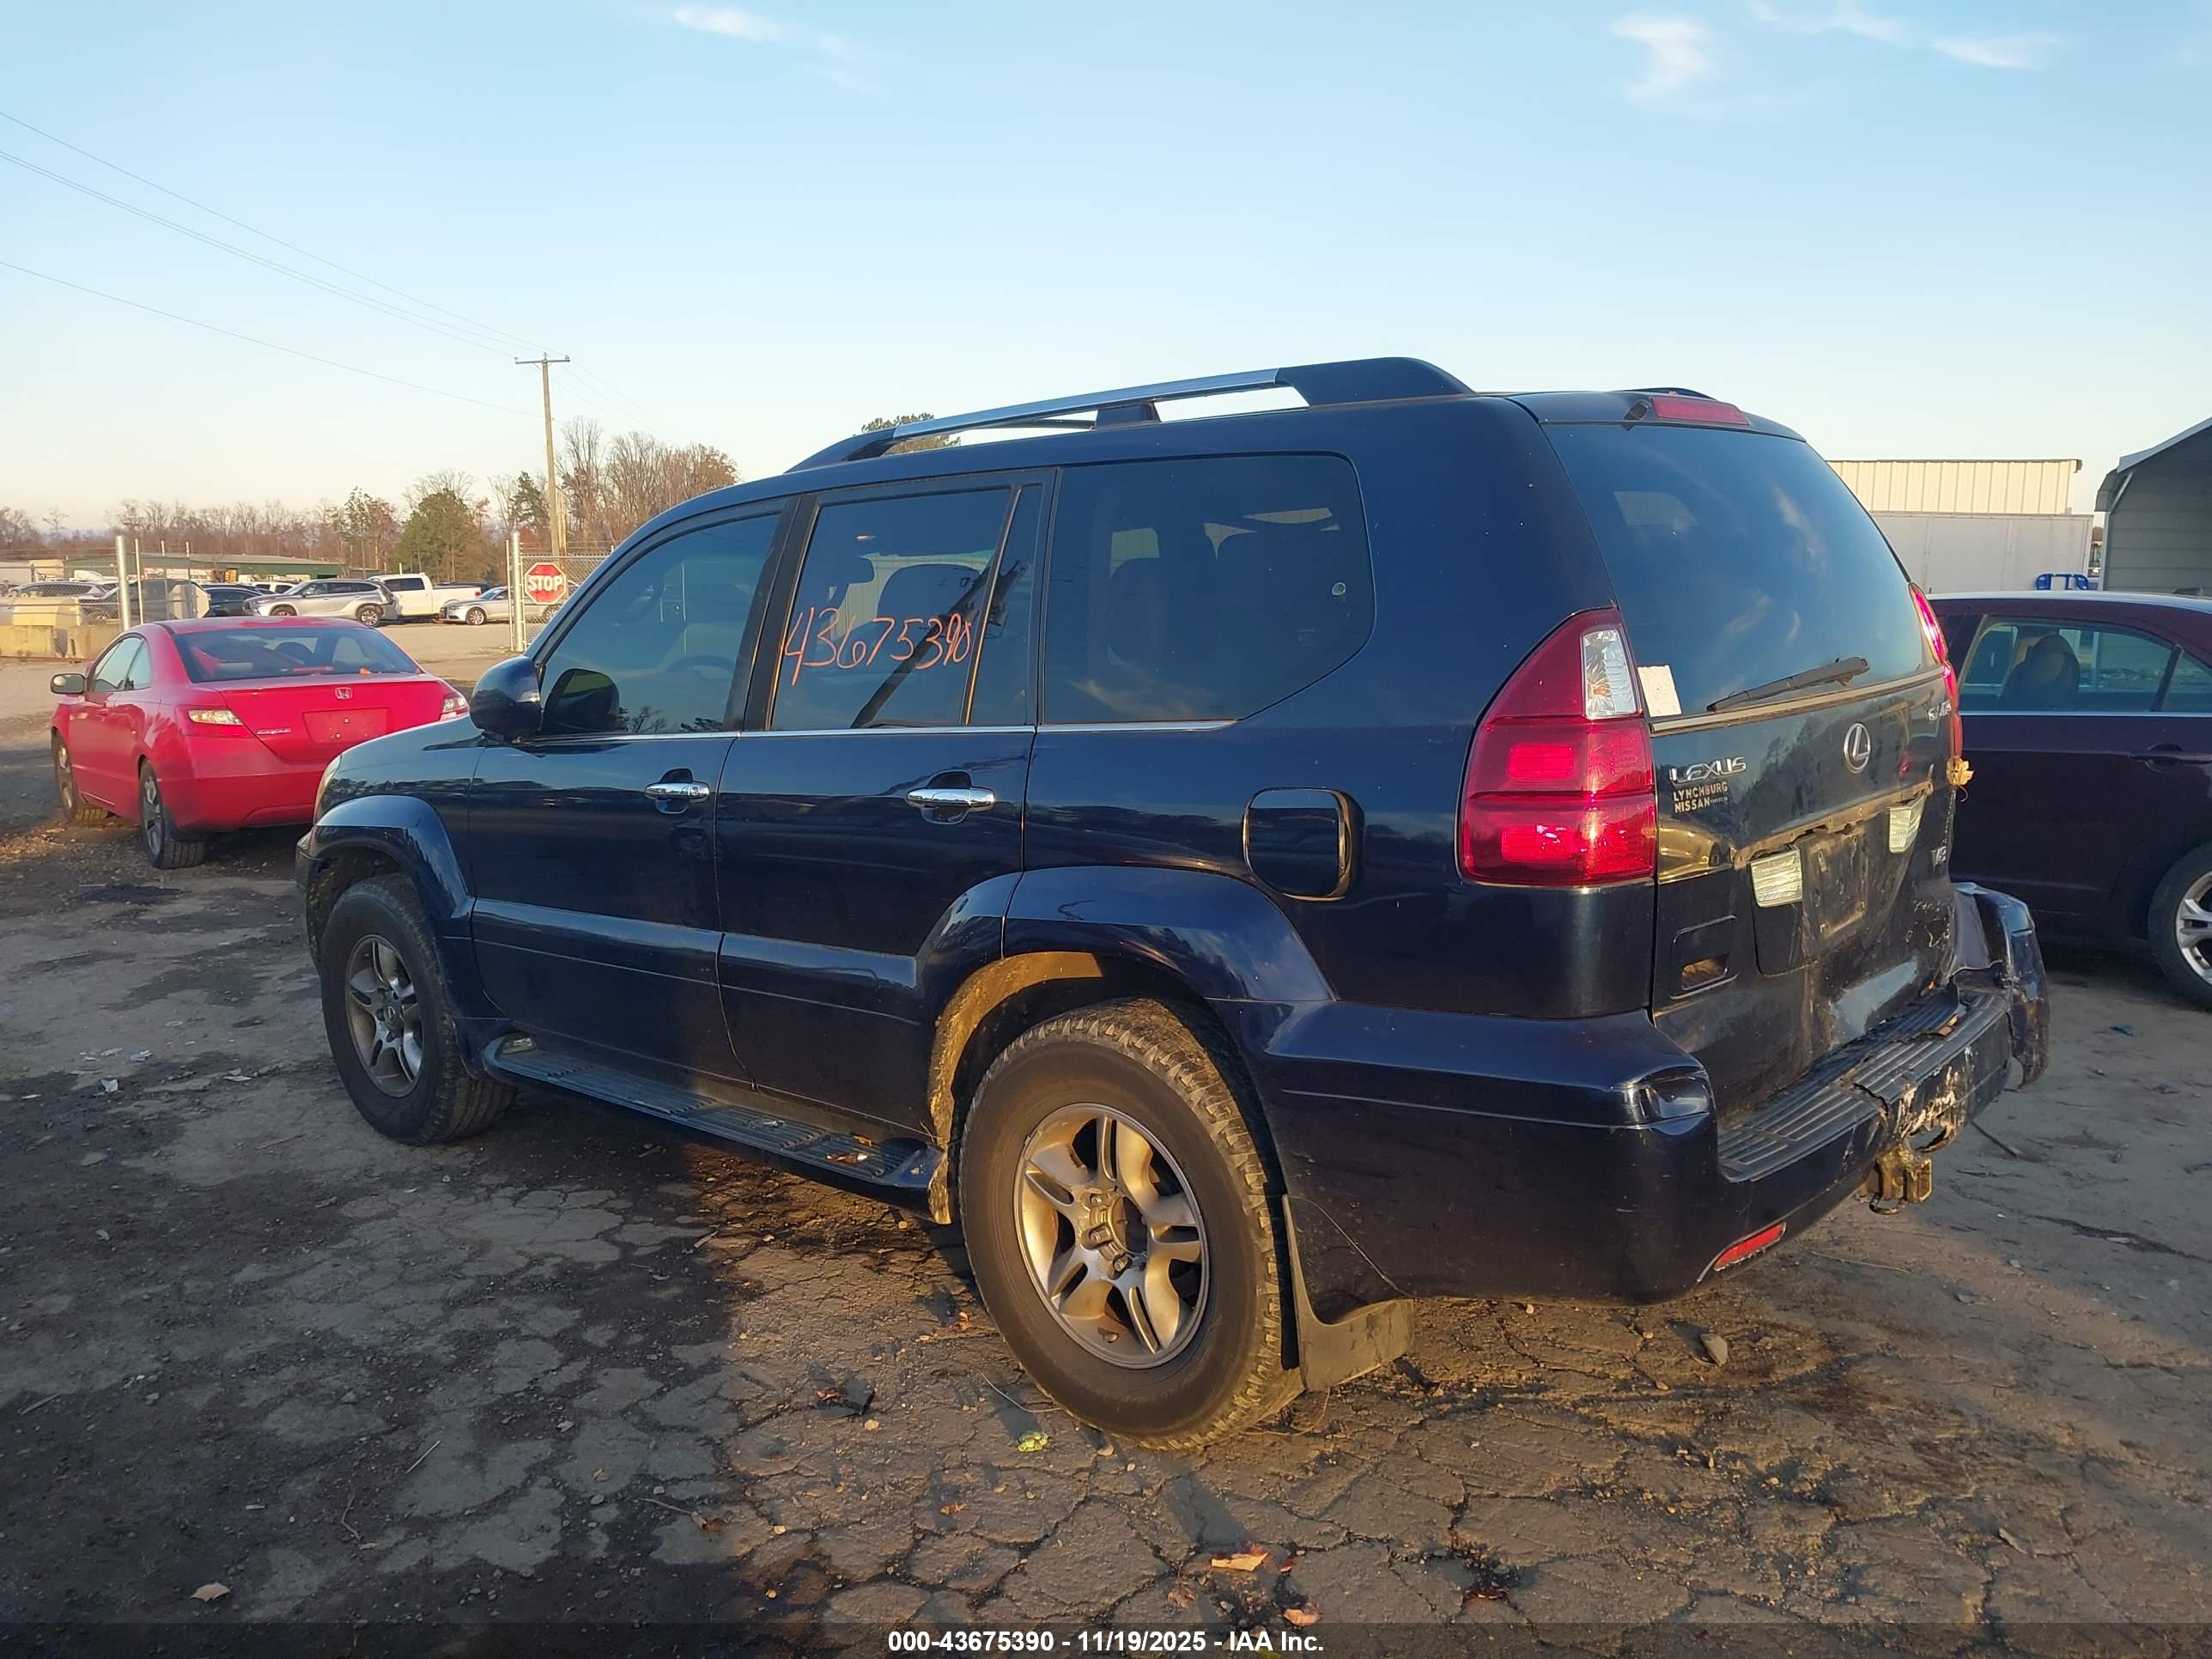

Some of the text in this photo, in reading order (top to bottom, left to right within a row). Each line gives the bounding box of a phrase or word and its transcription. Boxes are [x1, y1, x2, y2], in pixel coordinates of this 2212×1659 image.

[528, 574, 563, 592] STOP
[785, 606, 972, 687] 43675390
[1669, 757, 1747, 785] LEXUS
[1673, 781, 1729, 802] LYNCHBURG
[1674, 796, 1711, 814] NISSAN
